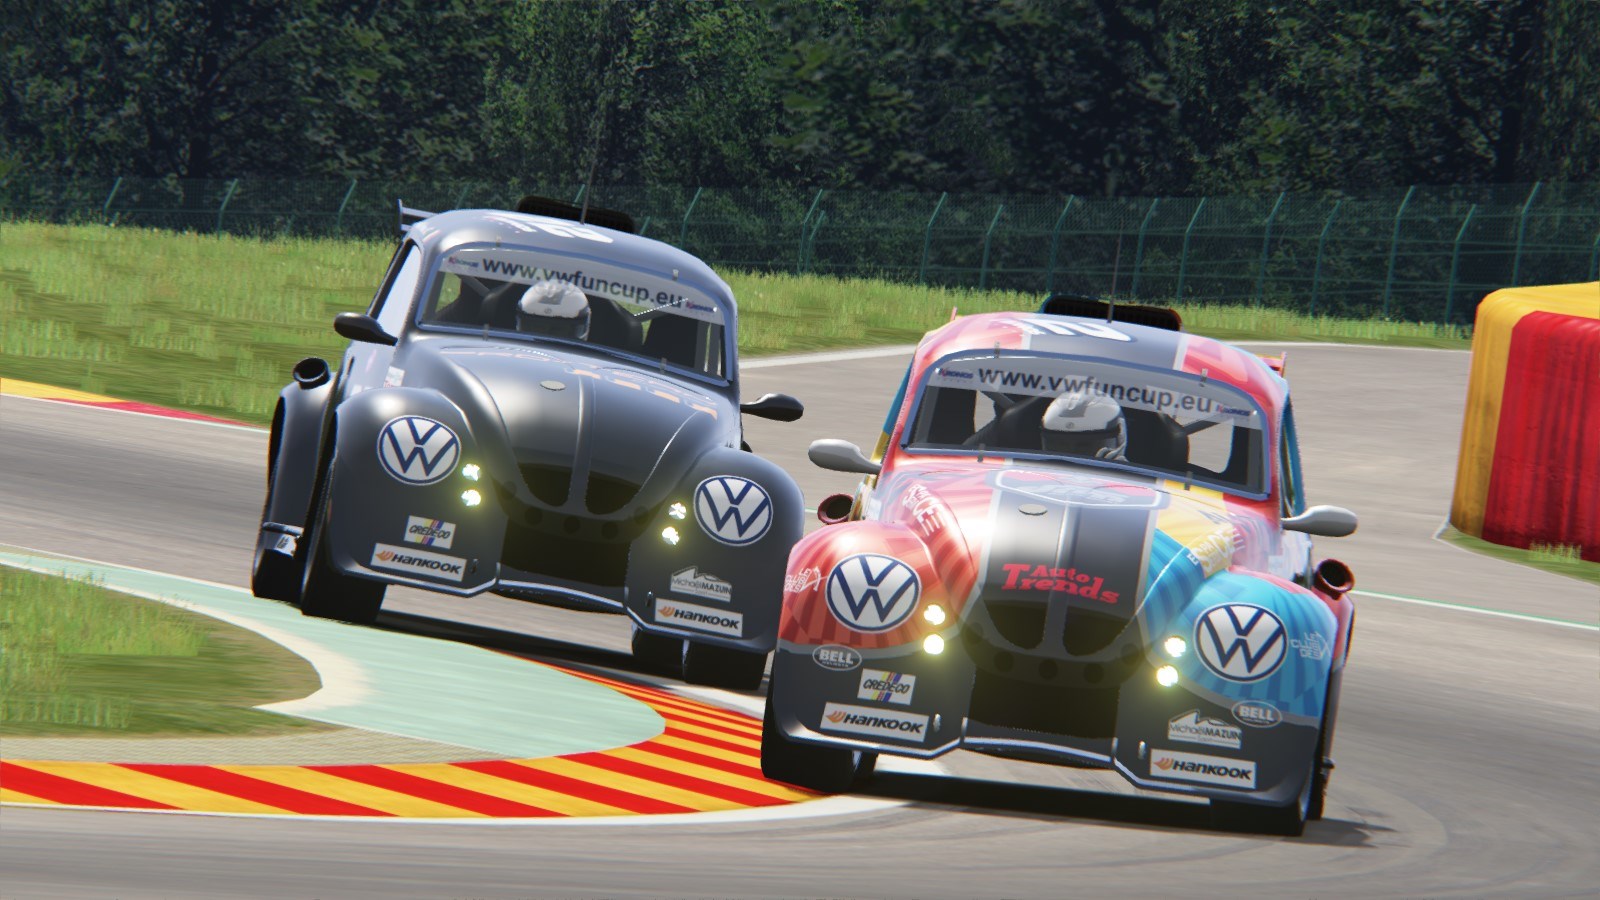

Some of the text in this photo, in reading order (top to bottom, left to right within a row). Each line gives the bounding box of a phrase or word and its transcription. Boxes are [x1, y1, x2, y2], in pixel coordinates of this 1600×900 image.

[482, 257, 683, 308] www.vwfuncup.eu
[978, 367, 1212, 414] www.vwfuncup.eu
[379, 417, 460, 484] VW
[696, 477, 771, 544] VW
[830, 555, 919, 631] VW
[1001, 563, 1121, 604] Trends
[1029, 564, 1091, 583] Auto
[818, 648, 854, 665] BELL
[1196, 604, 1285, 681] VW
[863, 679, 911, 694] CREDECO
[1238, 705, 1275, 722] BELL
